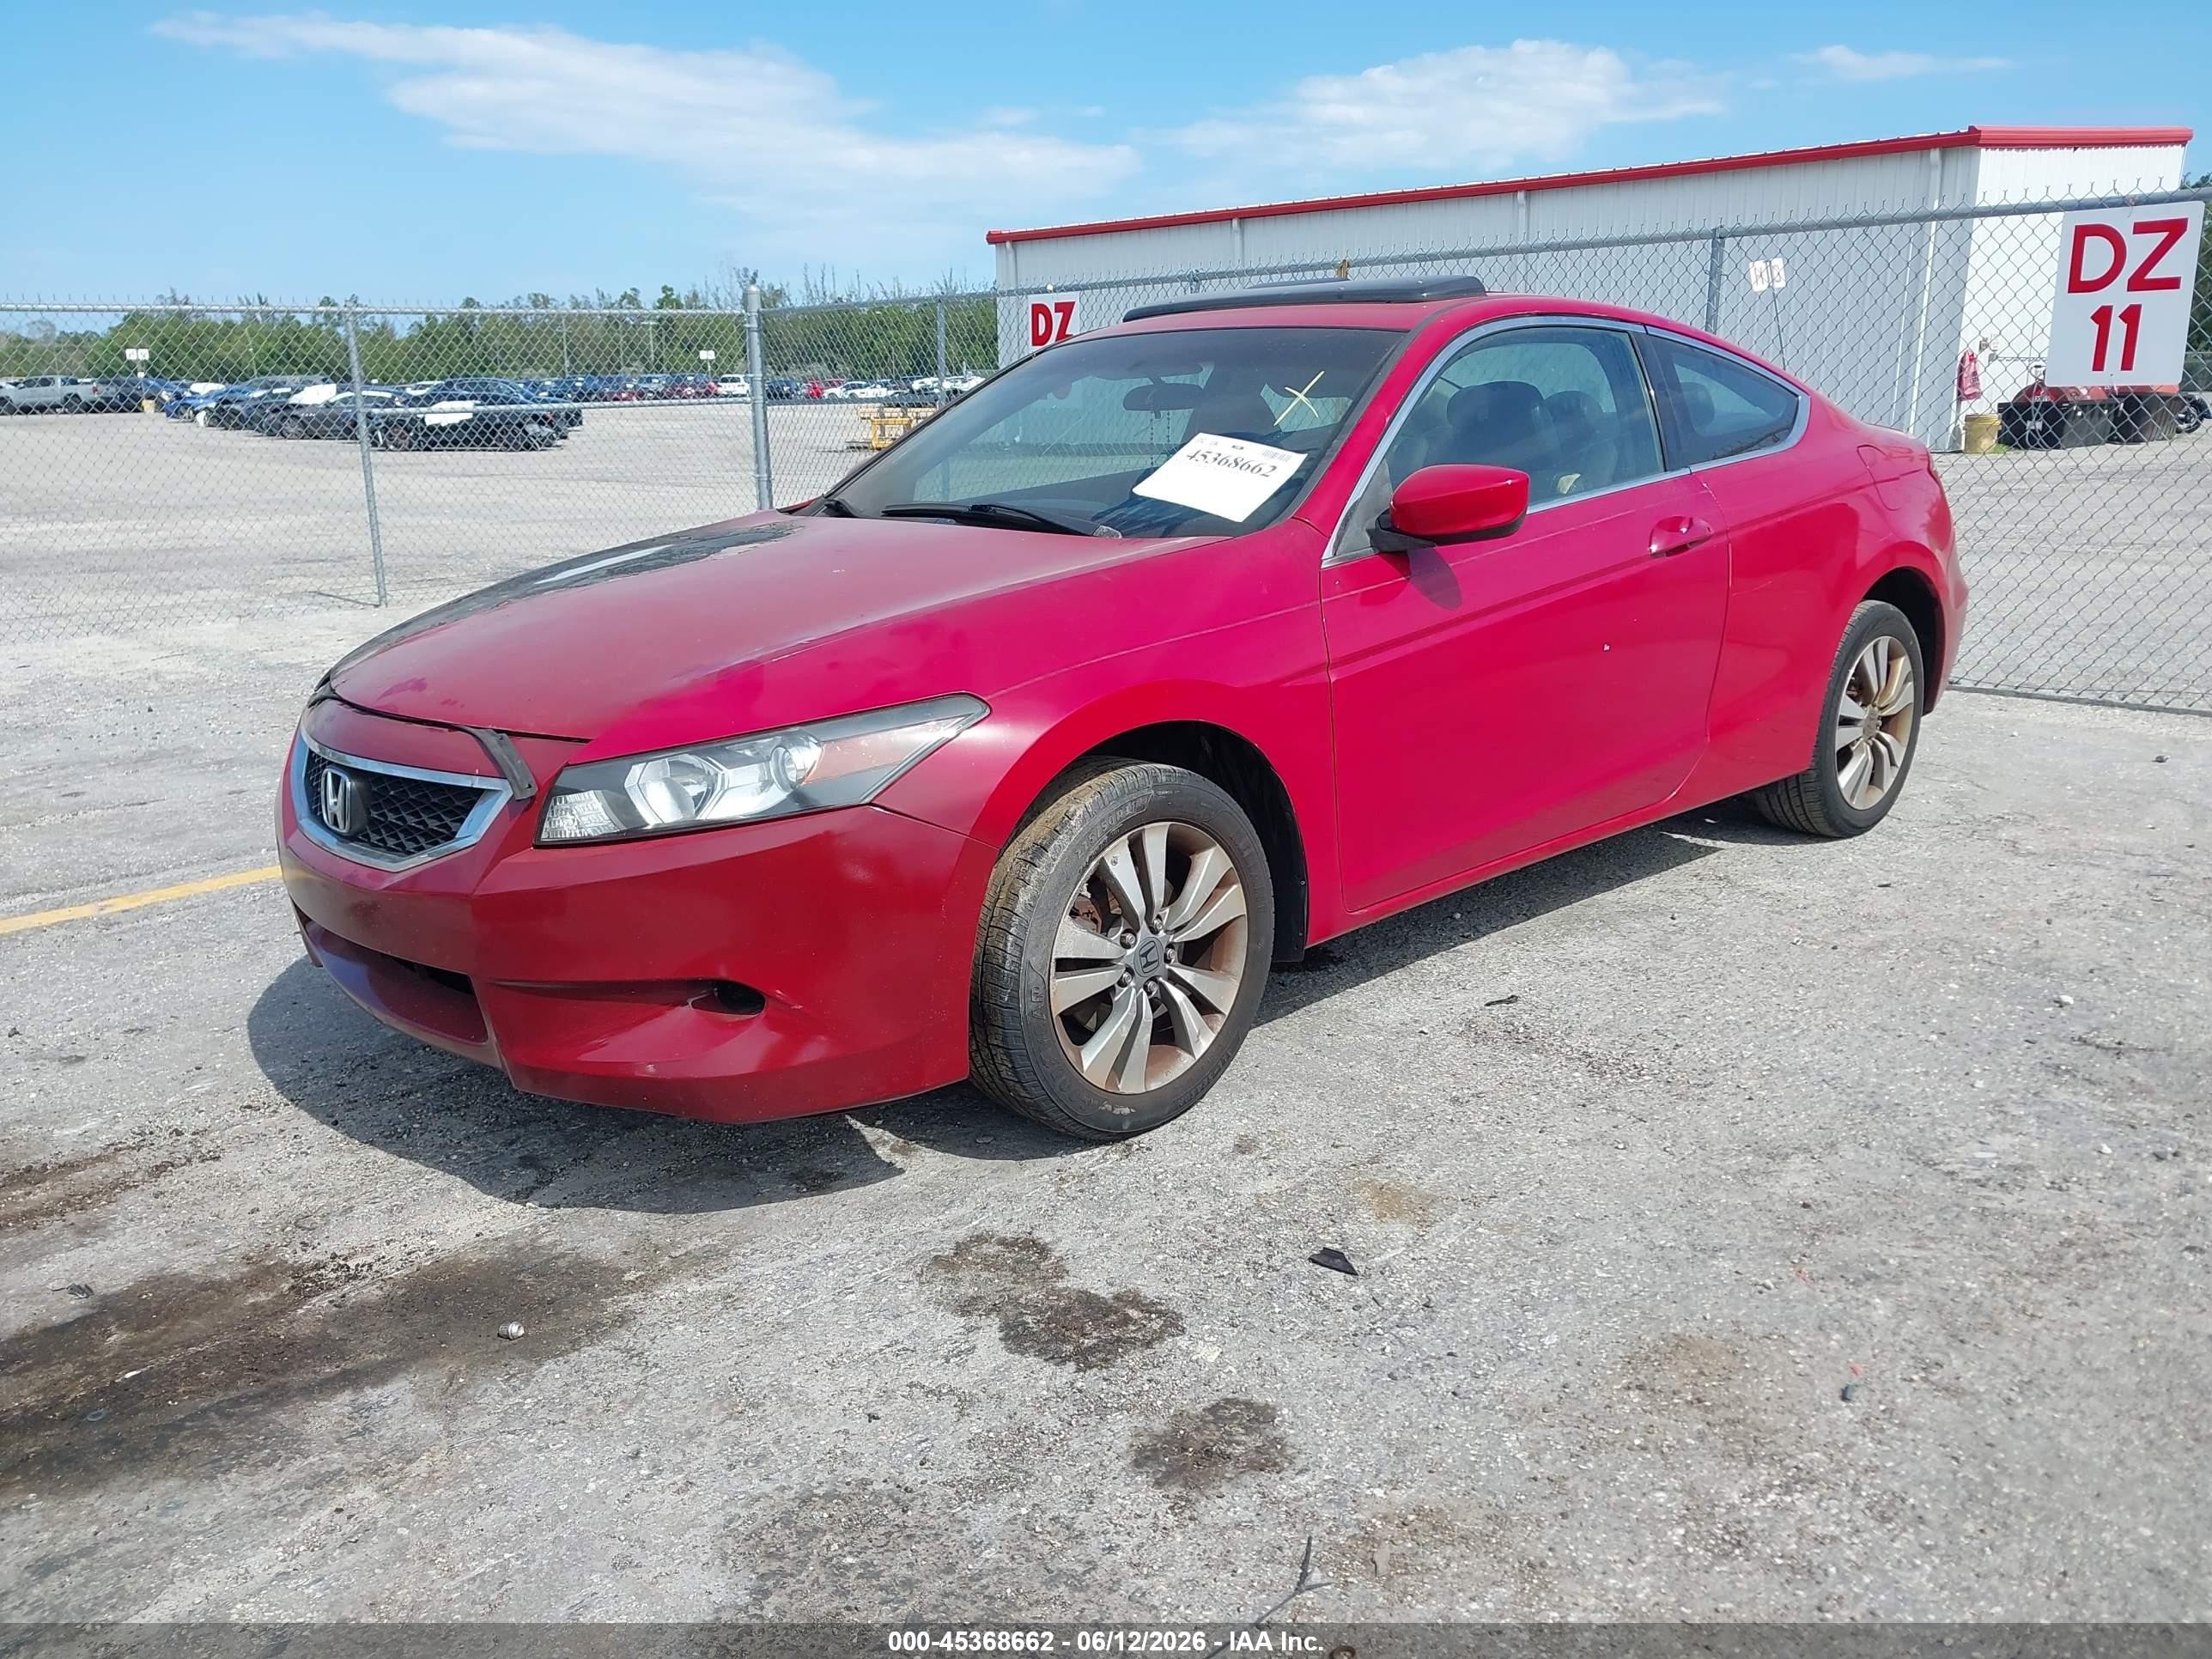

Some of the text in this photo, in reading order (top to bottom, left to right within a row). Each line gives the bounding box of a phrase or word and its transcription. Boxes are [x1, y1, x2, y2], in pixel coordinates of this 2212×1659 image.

[2067, 217, 2189, 294] DZ
[1030, 301, 1076, 347] DZ
[2090, 303, 2142, 372] 11
[1186, 449, 1277, 477] 45368662
